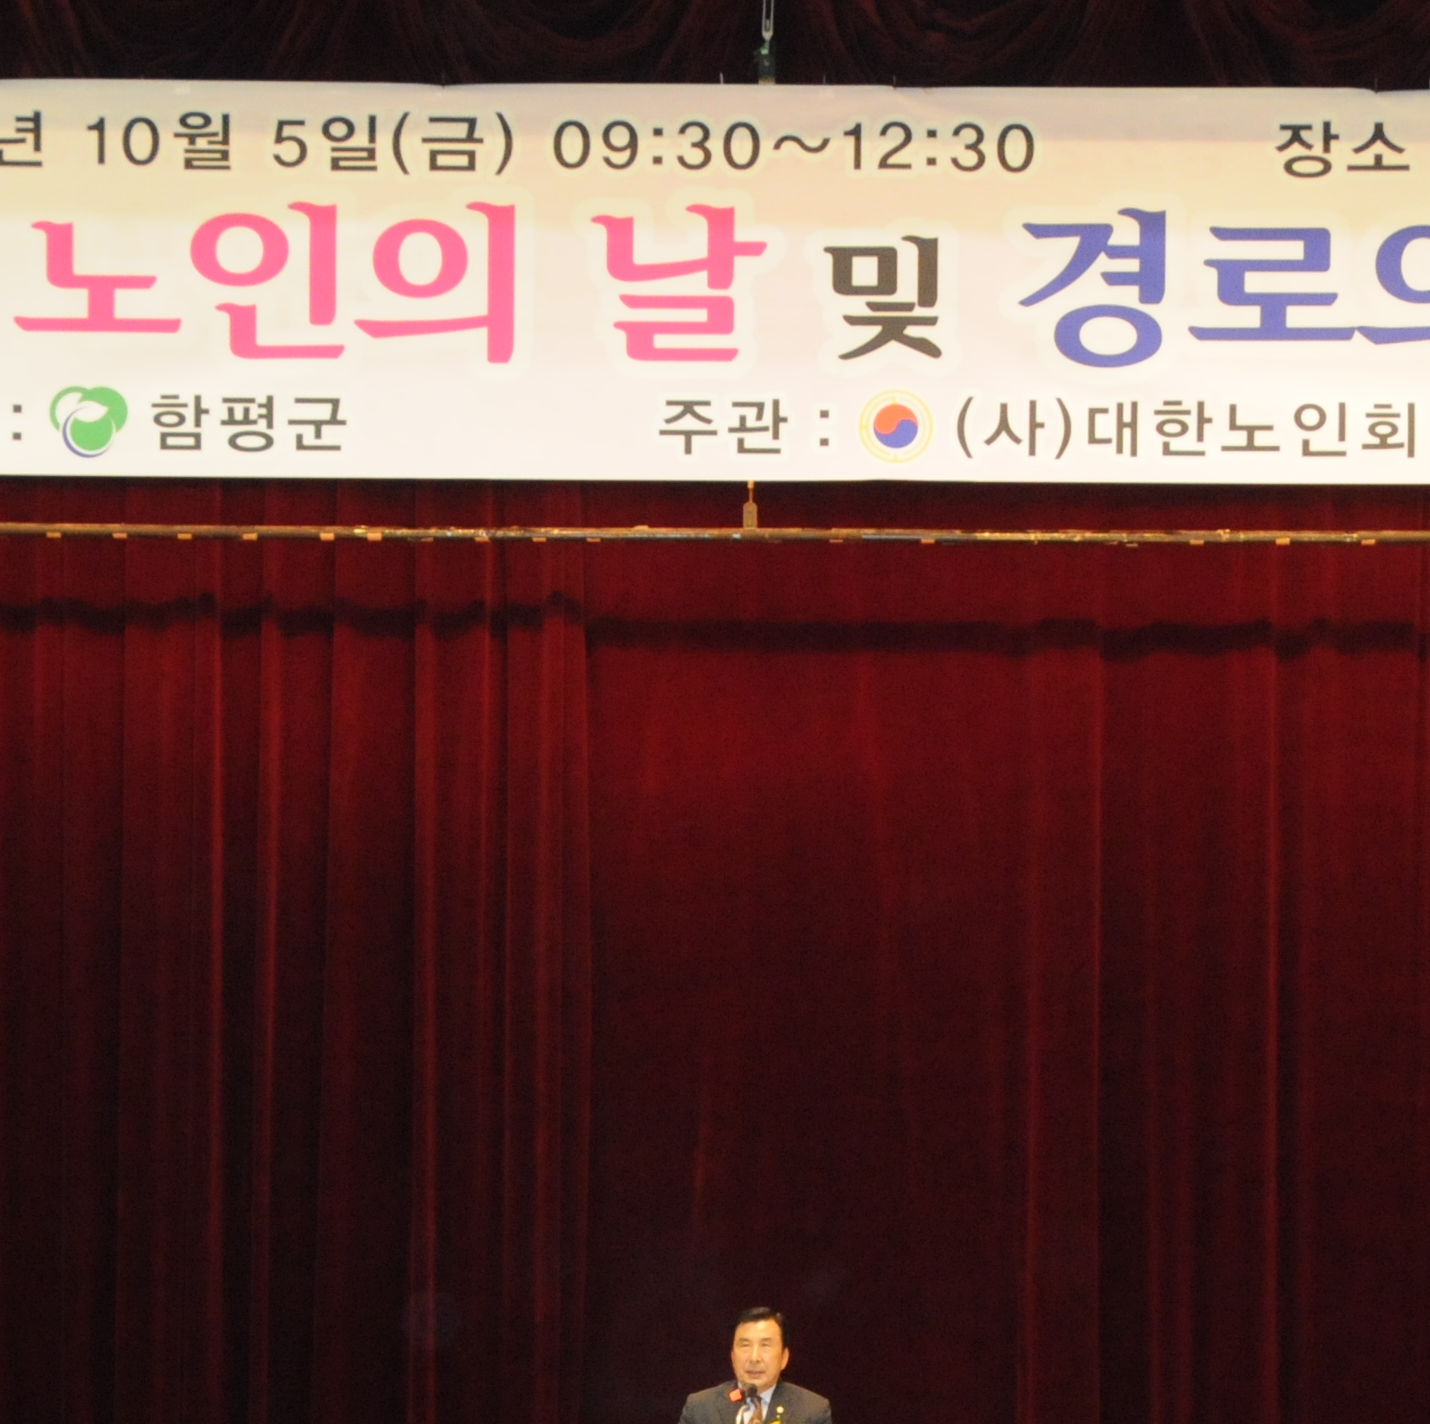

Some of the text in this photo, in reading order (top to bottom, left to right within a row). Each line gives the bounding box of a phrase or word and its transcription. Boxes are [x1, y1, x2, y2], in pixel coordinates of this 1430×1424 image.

[87, 112, 230, 170] 10월
[274, 112, 512, 175] 5일(금)
[1276, 121, 1409, 177] 장소
[14, 202, 515, 363] 노인의
[591, 204, 767, 361] 날
[824, 235, 942, 360] 및
[152, 395, 346, 452] 함평군
[659, 399, 788, 454] 주관
[957, 397, 1415, 459] (사)대한노인회
